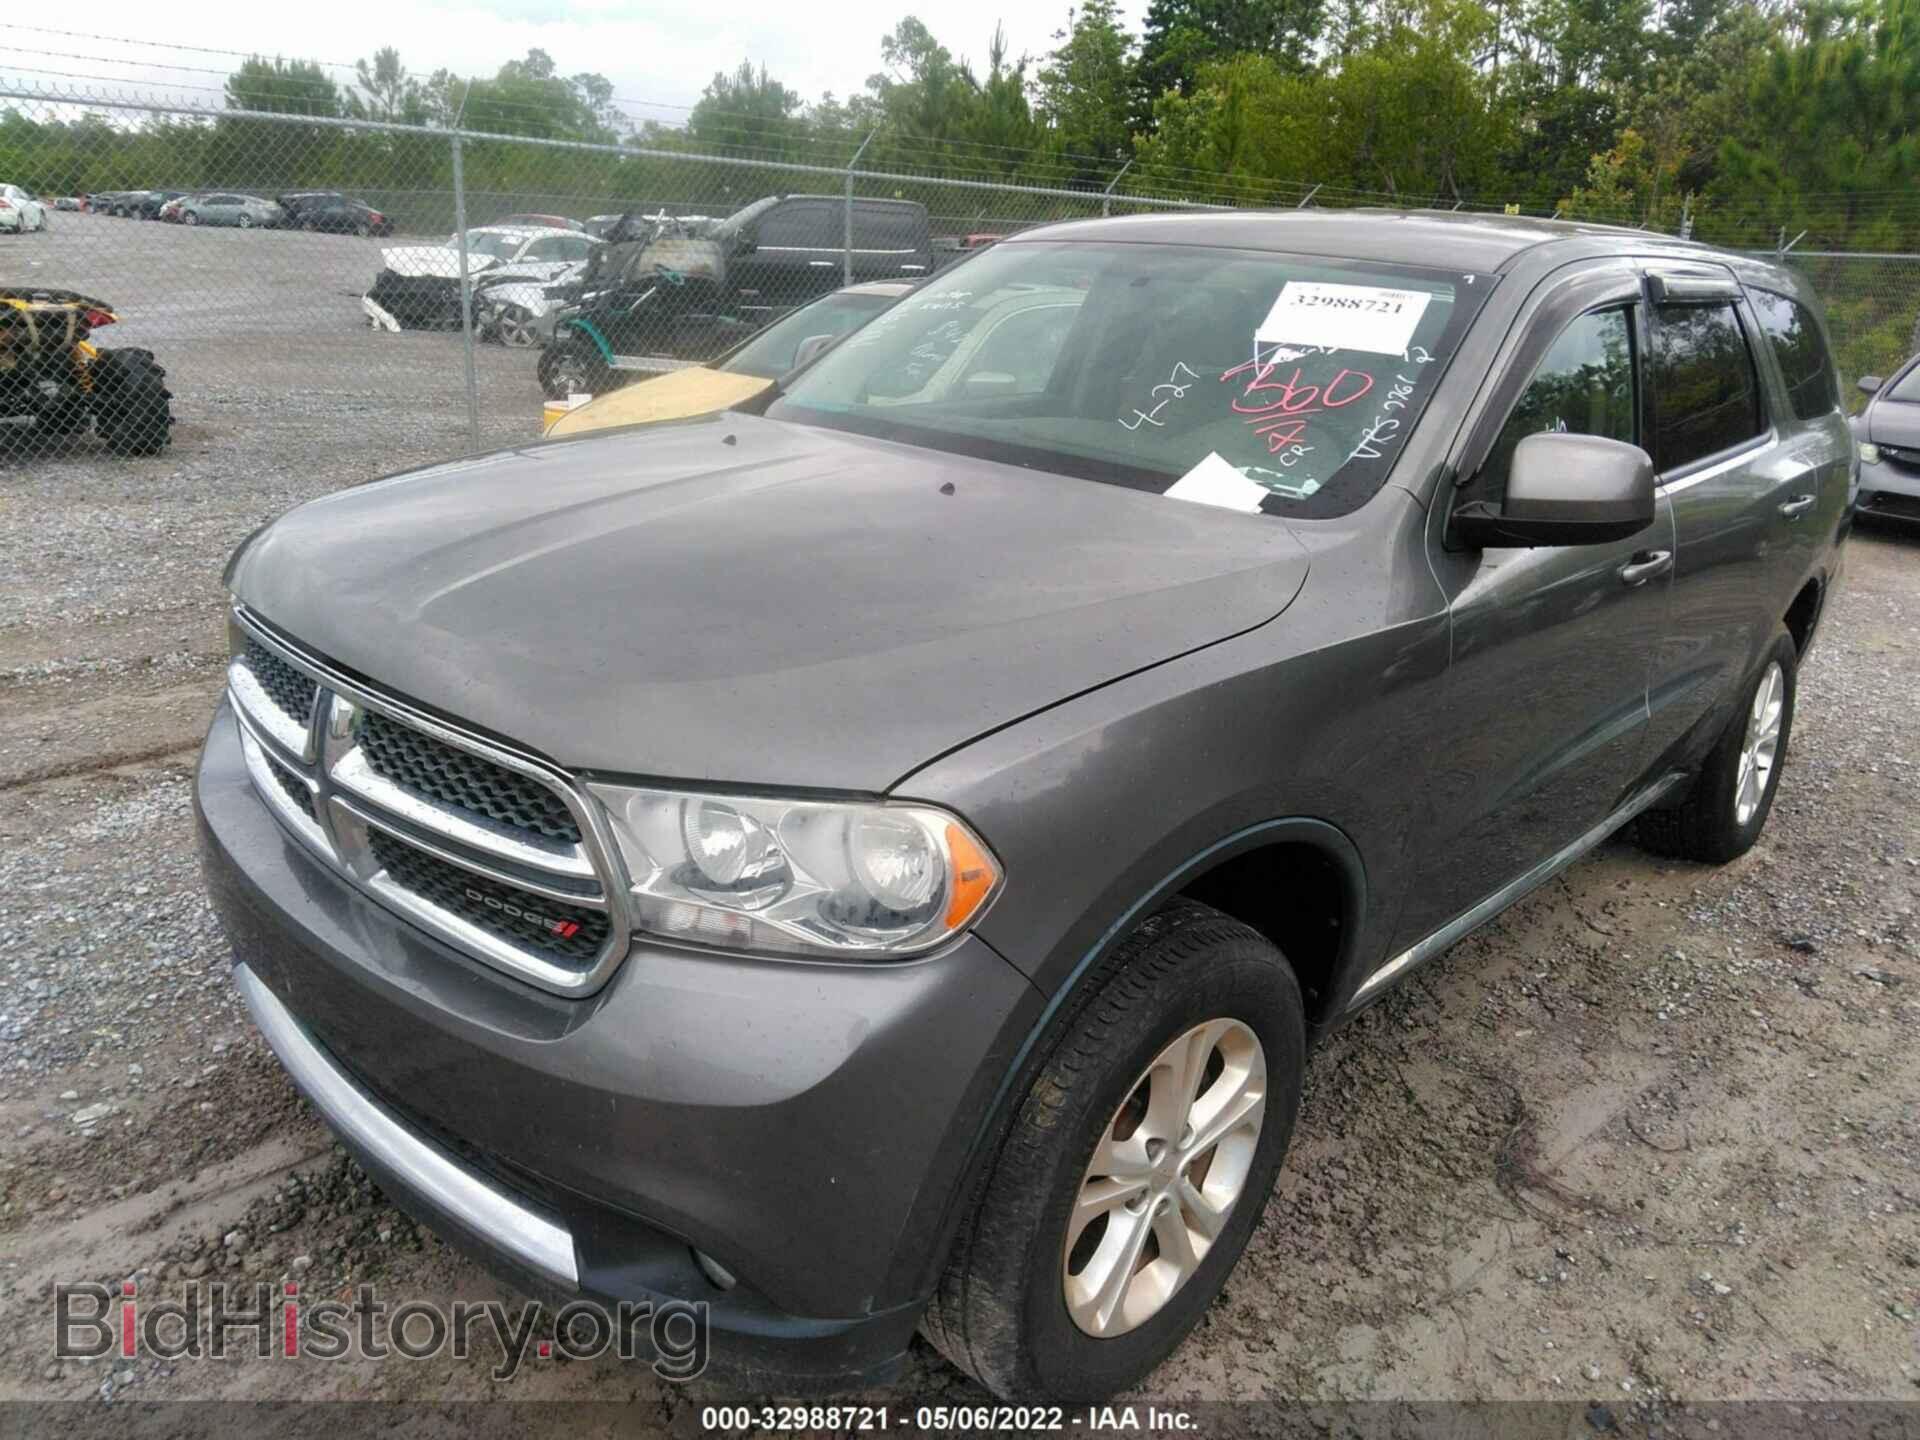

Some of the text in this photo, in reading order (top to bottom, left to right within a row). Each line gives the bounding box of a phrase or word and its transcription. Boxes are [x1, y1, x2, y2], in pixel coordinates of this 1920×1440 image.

[1289, 294, 1404, 314] 32988721
[1118, 361, 1201, 430] 4-27
[465, 888, 563, 932] DODGE
